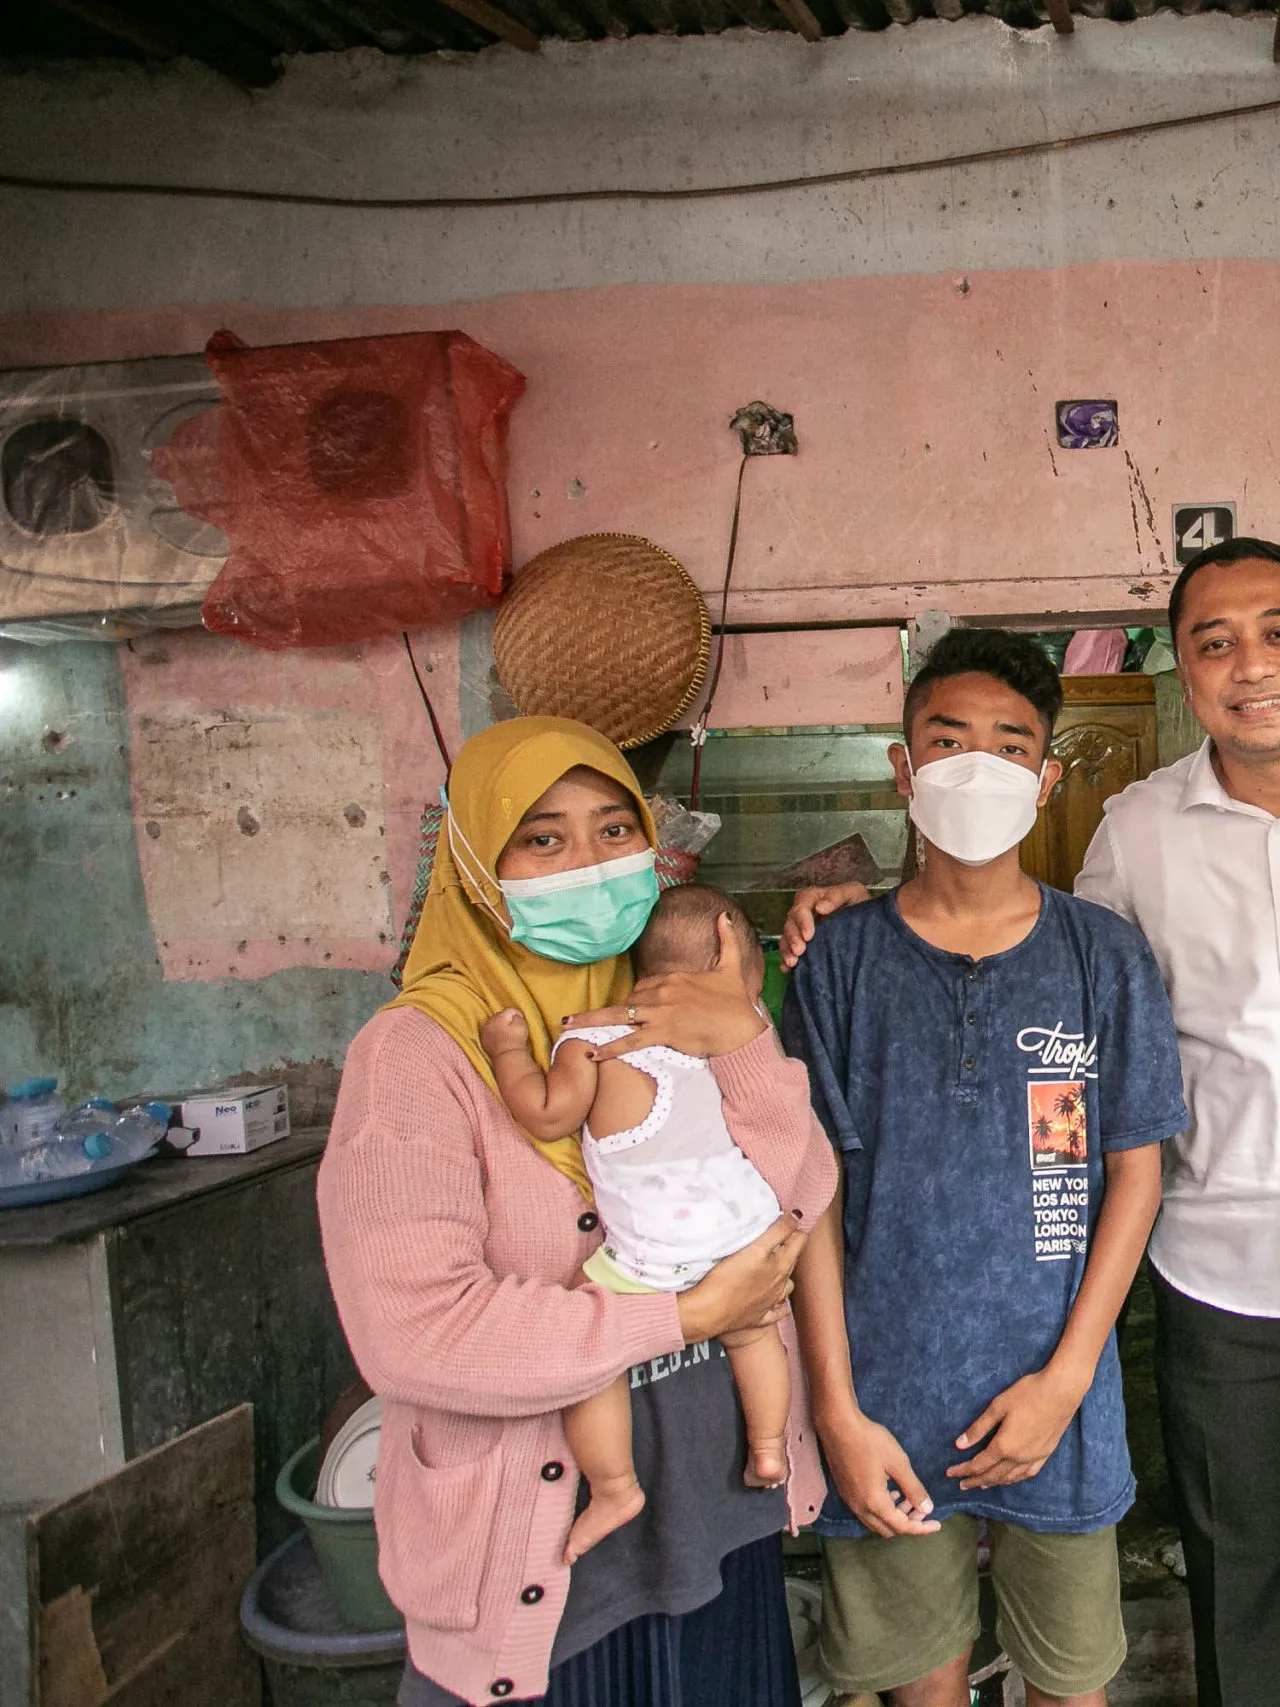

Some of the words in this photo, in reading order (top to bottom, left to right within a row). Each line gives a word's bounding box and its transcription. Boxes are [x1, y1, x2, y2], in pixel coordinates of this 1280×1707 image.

[1182, 512, 1224, 550] 4
[1032, 1178, 1062, 1192] NEW
[1033, 1194, 1058, 1208] LOS
[1060, 1193, 1088, 1206] ANG
[1033, 1209, 1078, 1223] TOKYO
[1034, 1223, 1087, 1238] LONDON
[1035, 1238, 1071, 1254] PARIS
